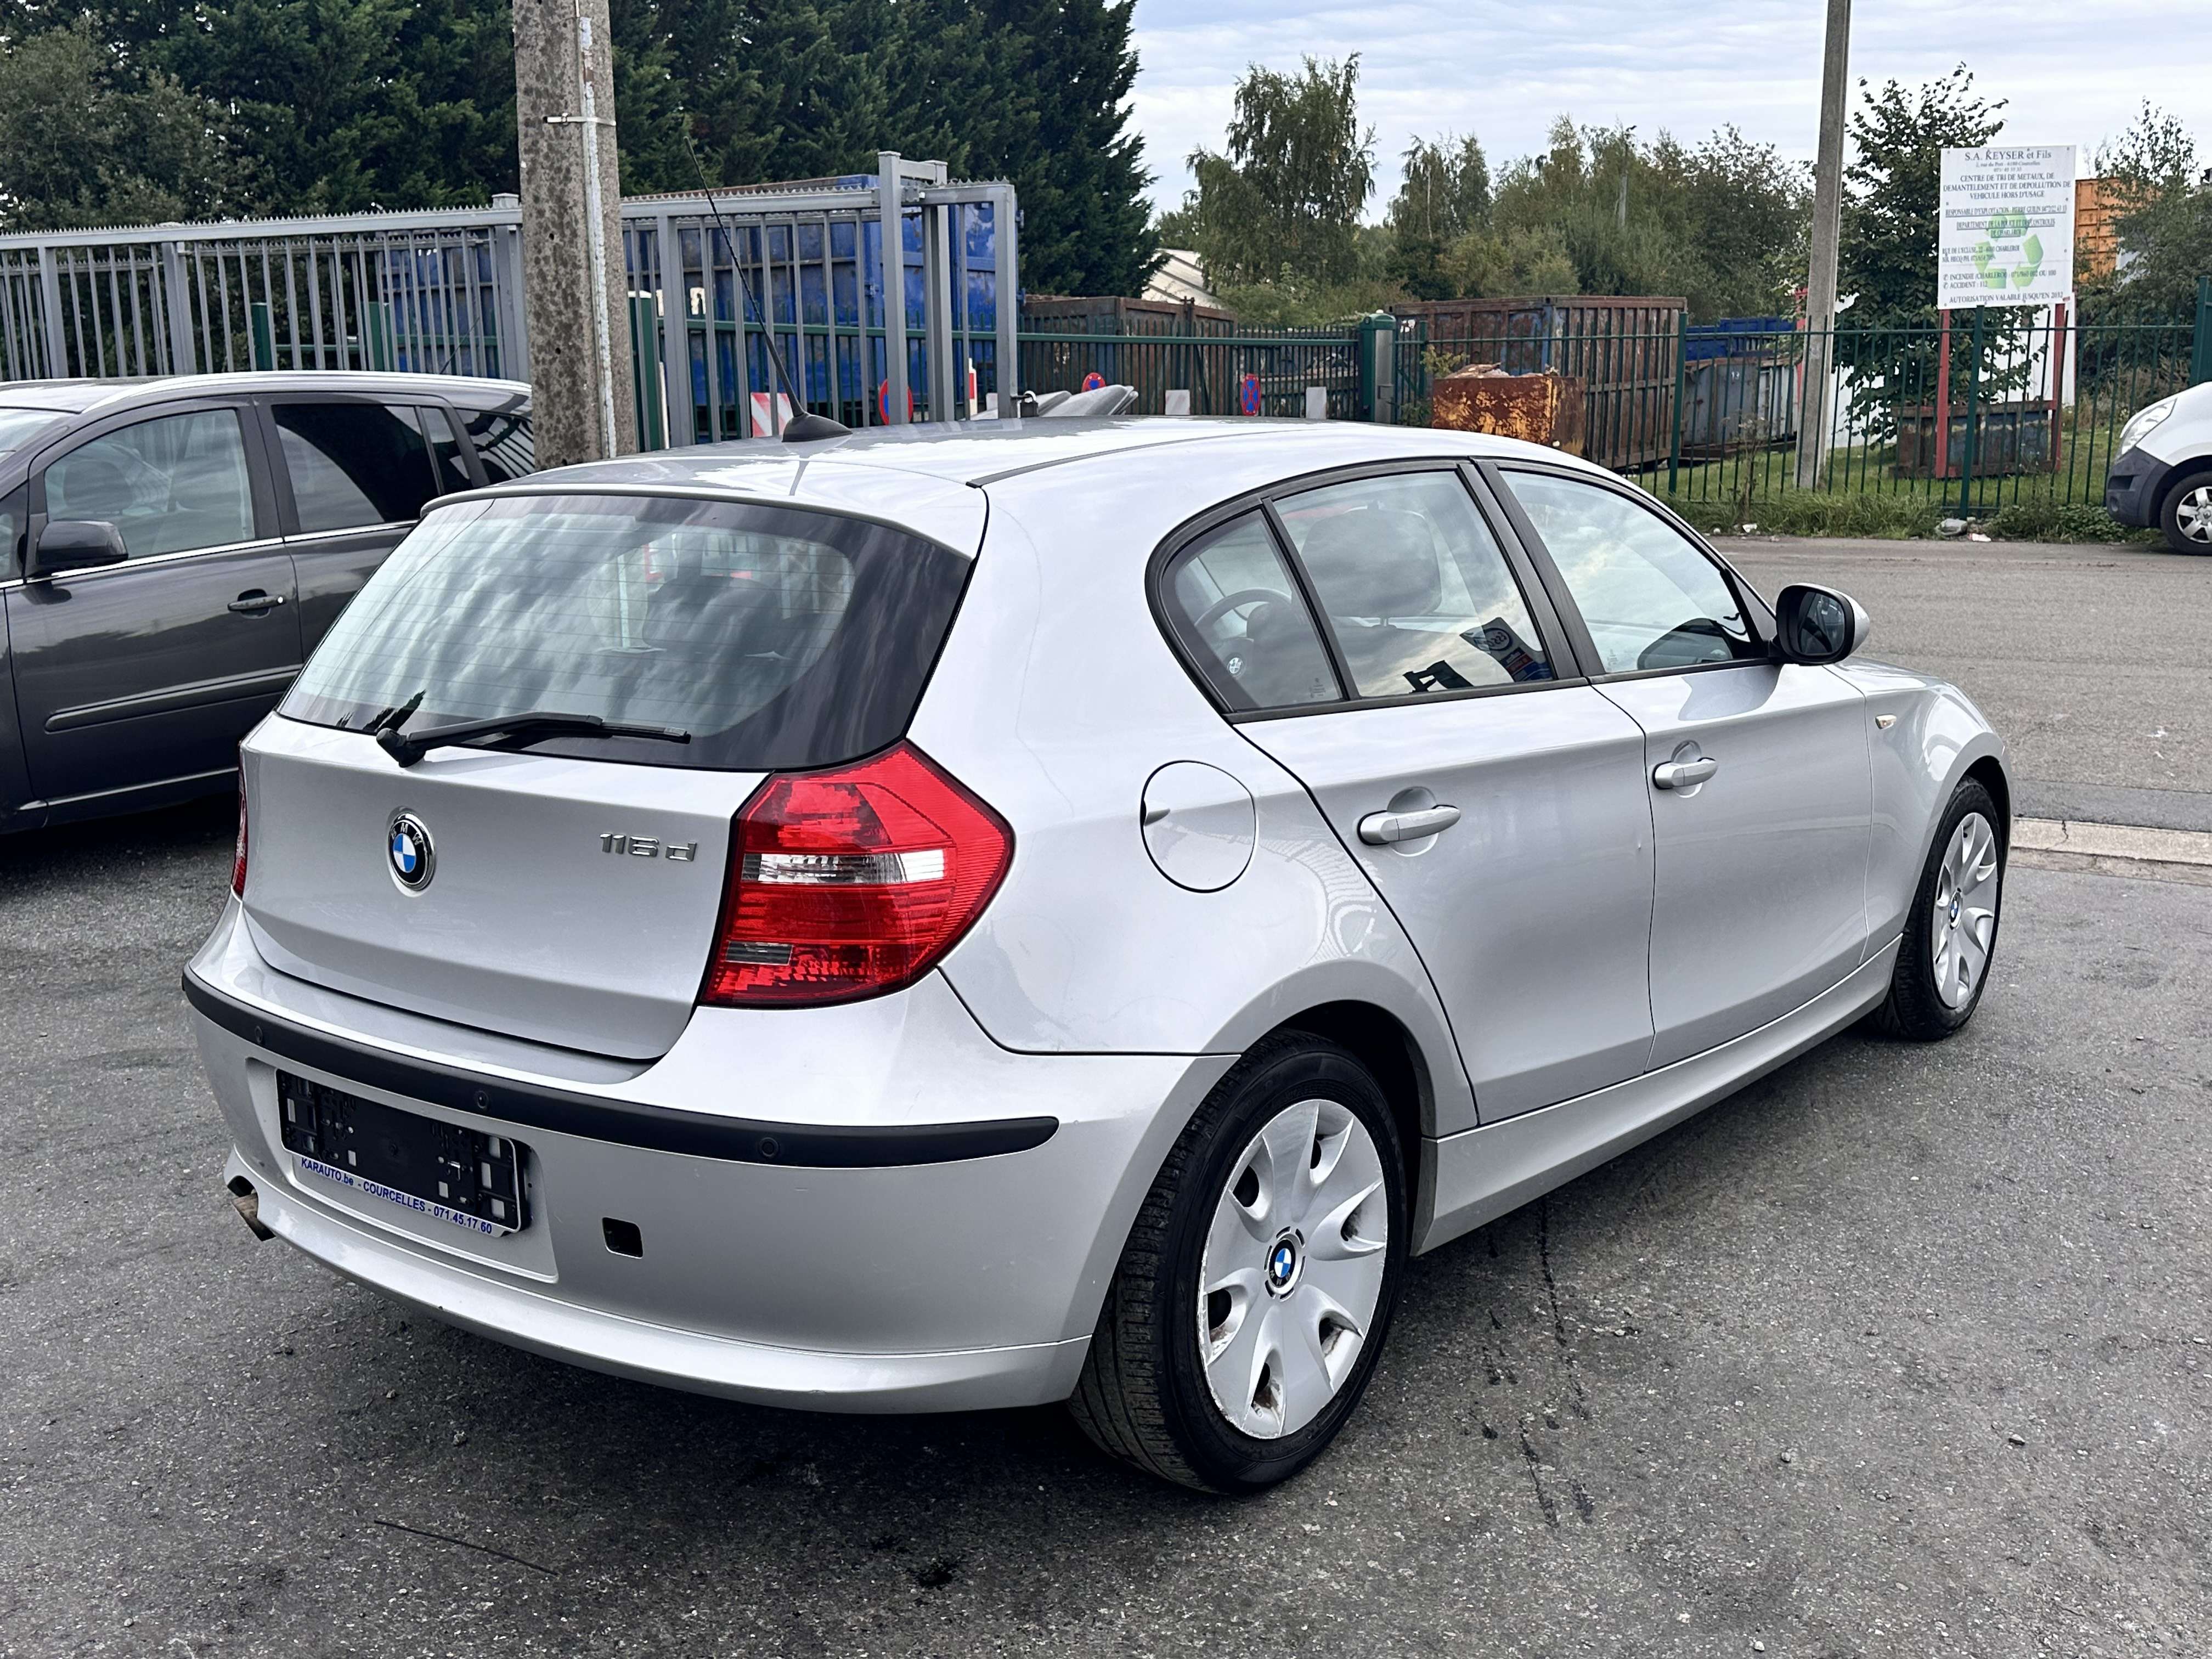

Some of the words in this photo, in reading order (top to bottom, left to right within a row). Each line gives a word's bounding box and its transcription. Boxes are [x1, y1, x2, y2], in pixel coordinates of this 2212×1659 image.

[1965, 151, 1983, 161] S.A.
[1985, 150, 2024, 160] KEYSER
[2027, 150, 2034, 159] et
[2036, 150, 2052, 159] Fils
[1943, 183, 1998, 192] DEMANTELEMENT
[2018, 180, 2062, 189] DEPOLLUTION
[1949, 295, 1994, 303] AUTORISATION
[1995, 293, 2021, 301] VALABLE
[391, 822, 422, 846] BMW
[301, 1157, 354, 1186] KARAUTO.be
[363, 1181, 426, 1212] COURCELLES
[433, 1205, 492, 1234] 071.45.17.60
